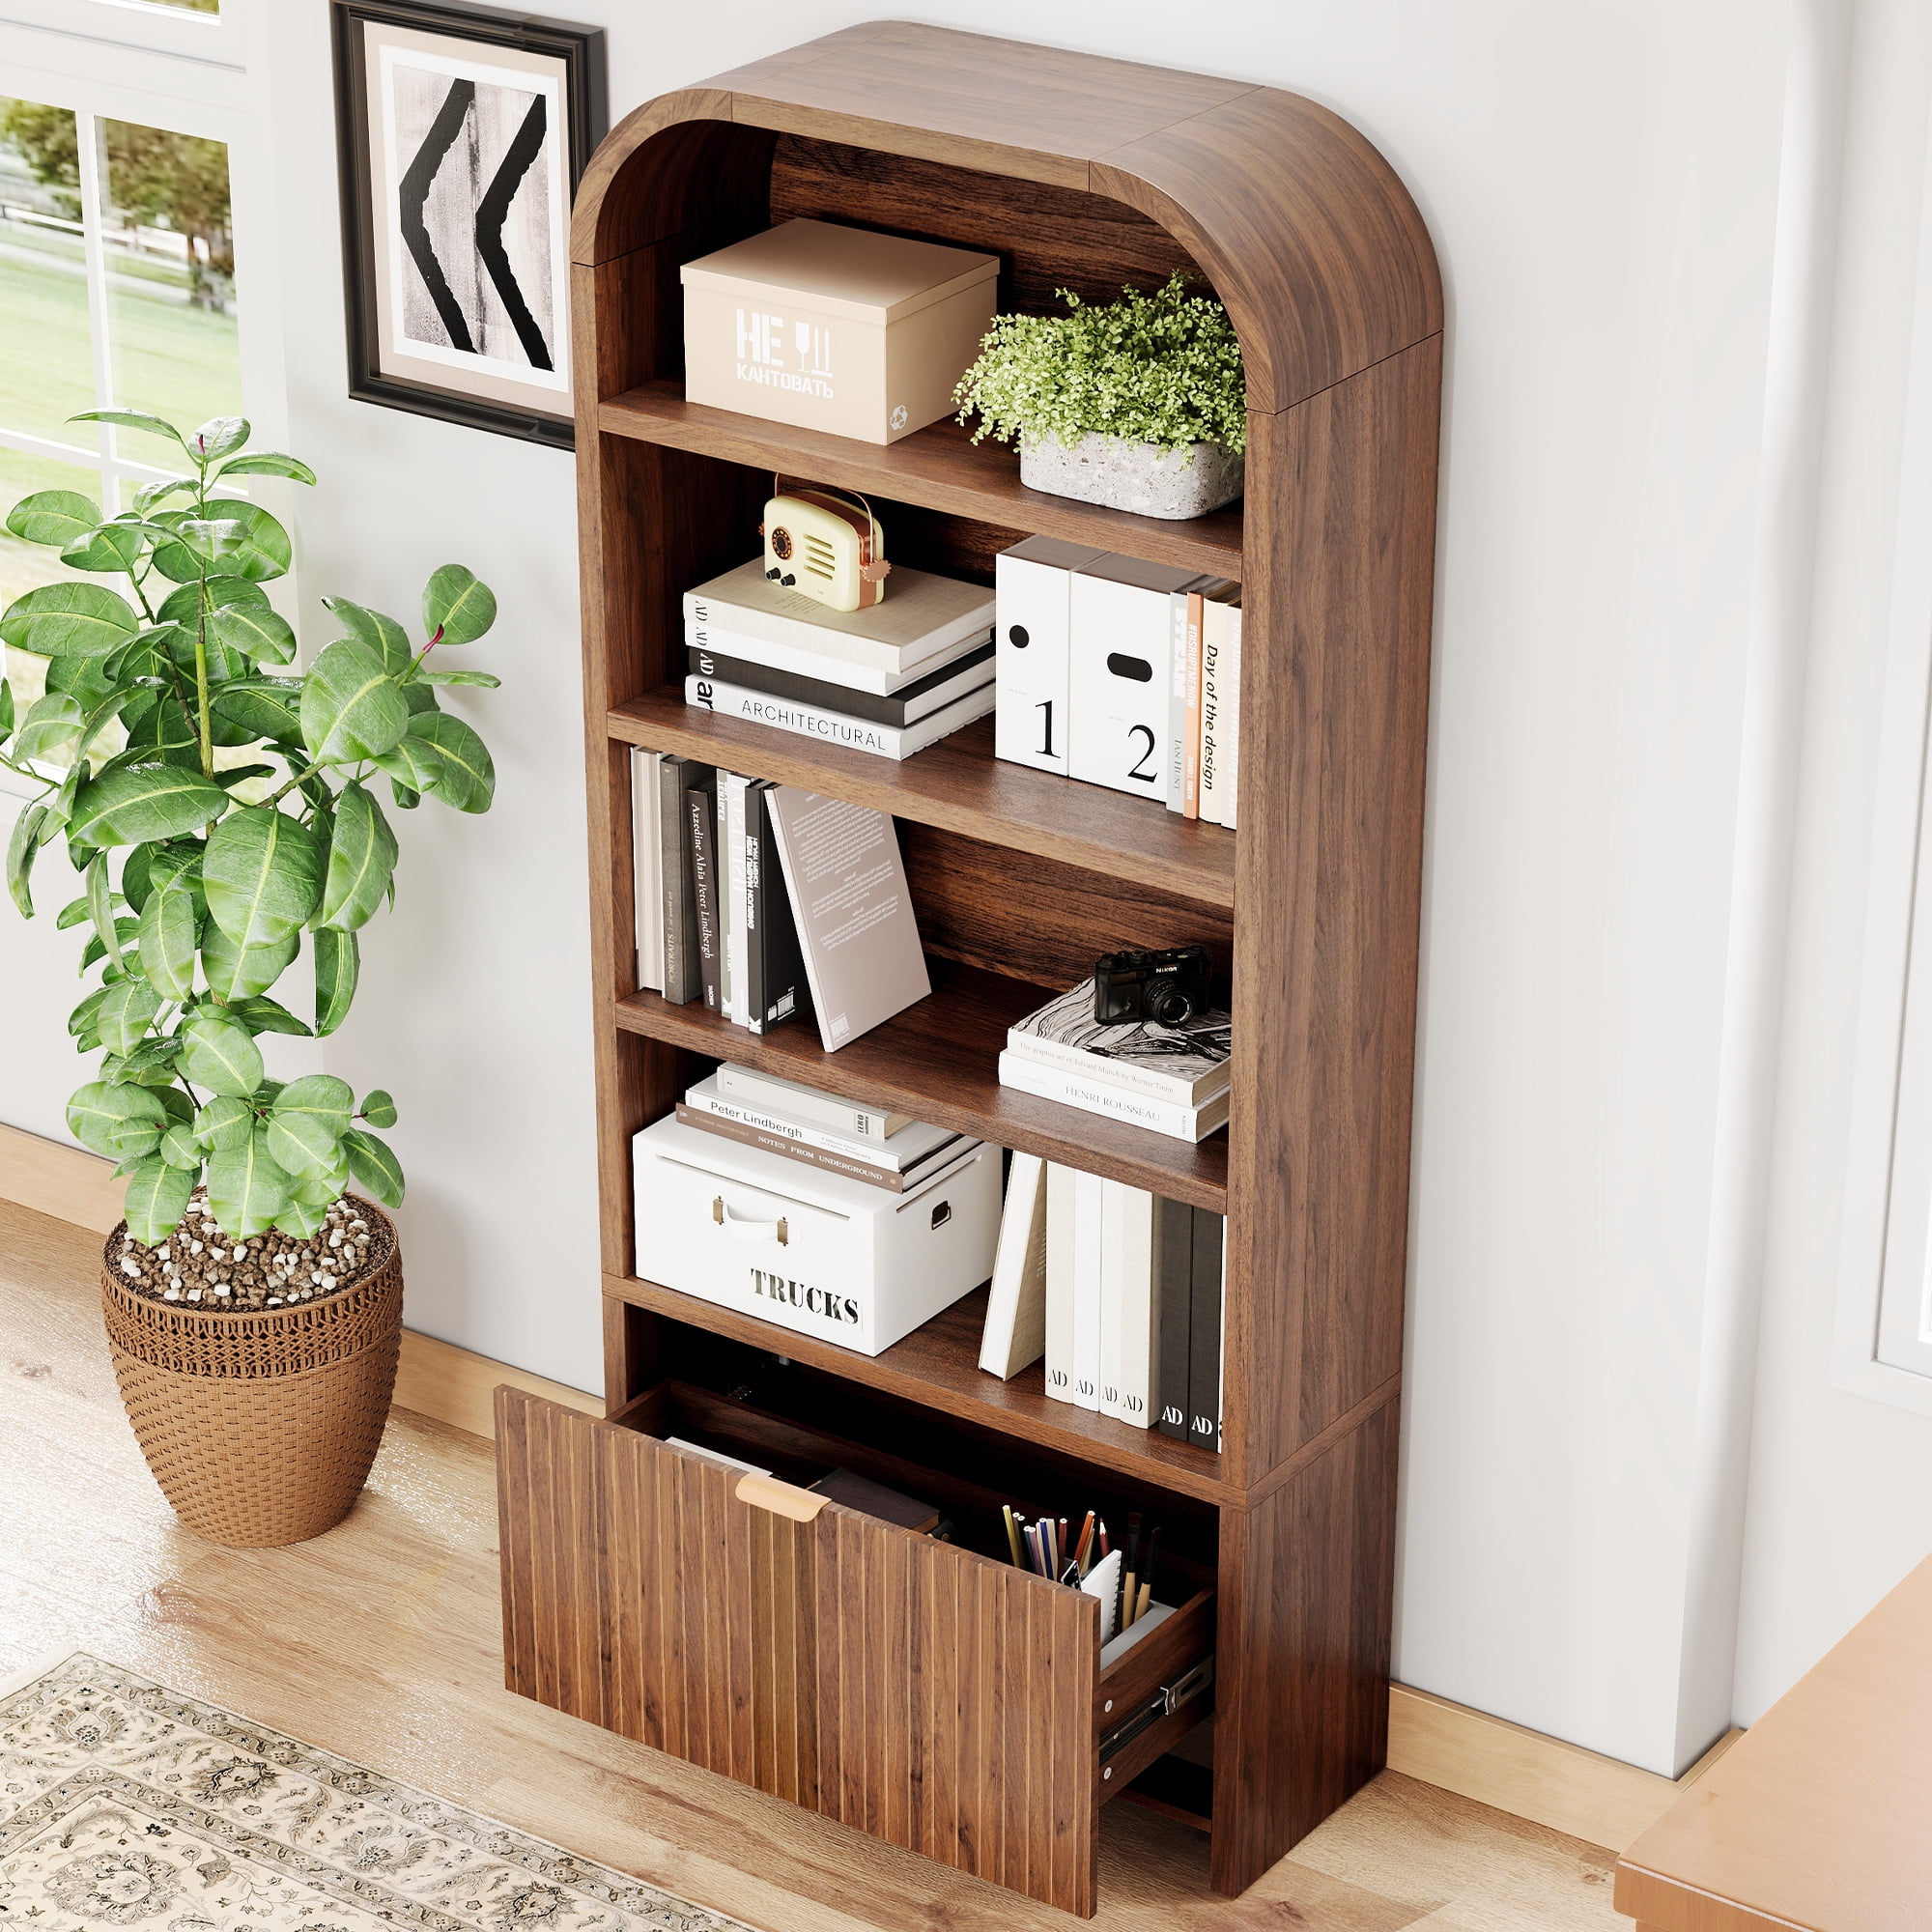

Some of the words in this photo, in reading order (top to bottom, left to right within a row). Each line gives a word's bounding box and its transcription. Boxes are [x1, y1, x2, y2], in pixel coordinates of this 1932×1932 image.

[736, 309, 783, 367] НЕ
[736, 362, 834, 399] КАНТОВАТЬ
[699, 652, 714, 675] AD
[1205, 644, 1218, 677] Day
[1206, 682, 1217, 700] of
[742, 699, 886, 751] ARCHITECTURAL
[1035, 699, 1061, 758] 1
[1206, 703, 1217, 730] the
[1127, 724, 1158, 783] 2
[1203, 735, 1216, 790] design
[692, 804, 703, 850] Azzedine
[696, 853, 706, 880] Alaïa
[698, 883, 708, 909] Peter
[700, 911, 714, 959] Lindbergh
[667, 933, 675, 983] PORTRAITS
[1019, 1041, 1032, 1052] The
[1032, 1045, 1055, 1060] graphic
[1056, 1051, 1065, 1061] art
[1065, 1054, 1074, 1064] of
[1074, 1057, 1097, 1070] Edvard
[1121, 1068, 1129, 1080] by
[1130, 1073, 1154, 1087] Werner
[711, 1101, 740, 1119] Peter
[743, 1112, 803, 1139] Lindbergh
[1065, 1086, 1099, 1103] HENRI
[1103, 1095, 1160, 1122] ROUSSEAU
[758, 1135, 786, 1150] NOTES
[790, 1145, 814, 1159] FROM
[818, 1154, 883, 1180] UNDERGROUND
[751, 1267, 859, 1325] TRUCKS
[1048, 1369, 1067, 1388] AD
[1075, 1378, 1094, 1396] AD
[1102, 1385, 1118, 1403] AD
[1122, 1394, 1143, 1412] AD
[1161, 1406, 1183, 1426] AD
[1191, 1415, 1213, 1435] AD
